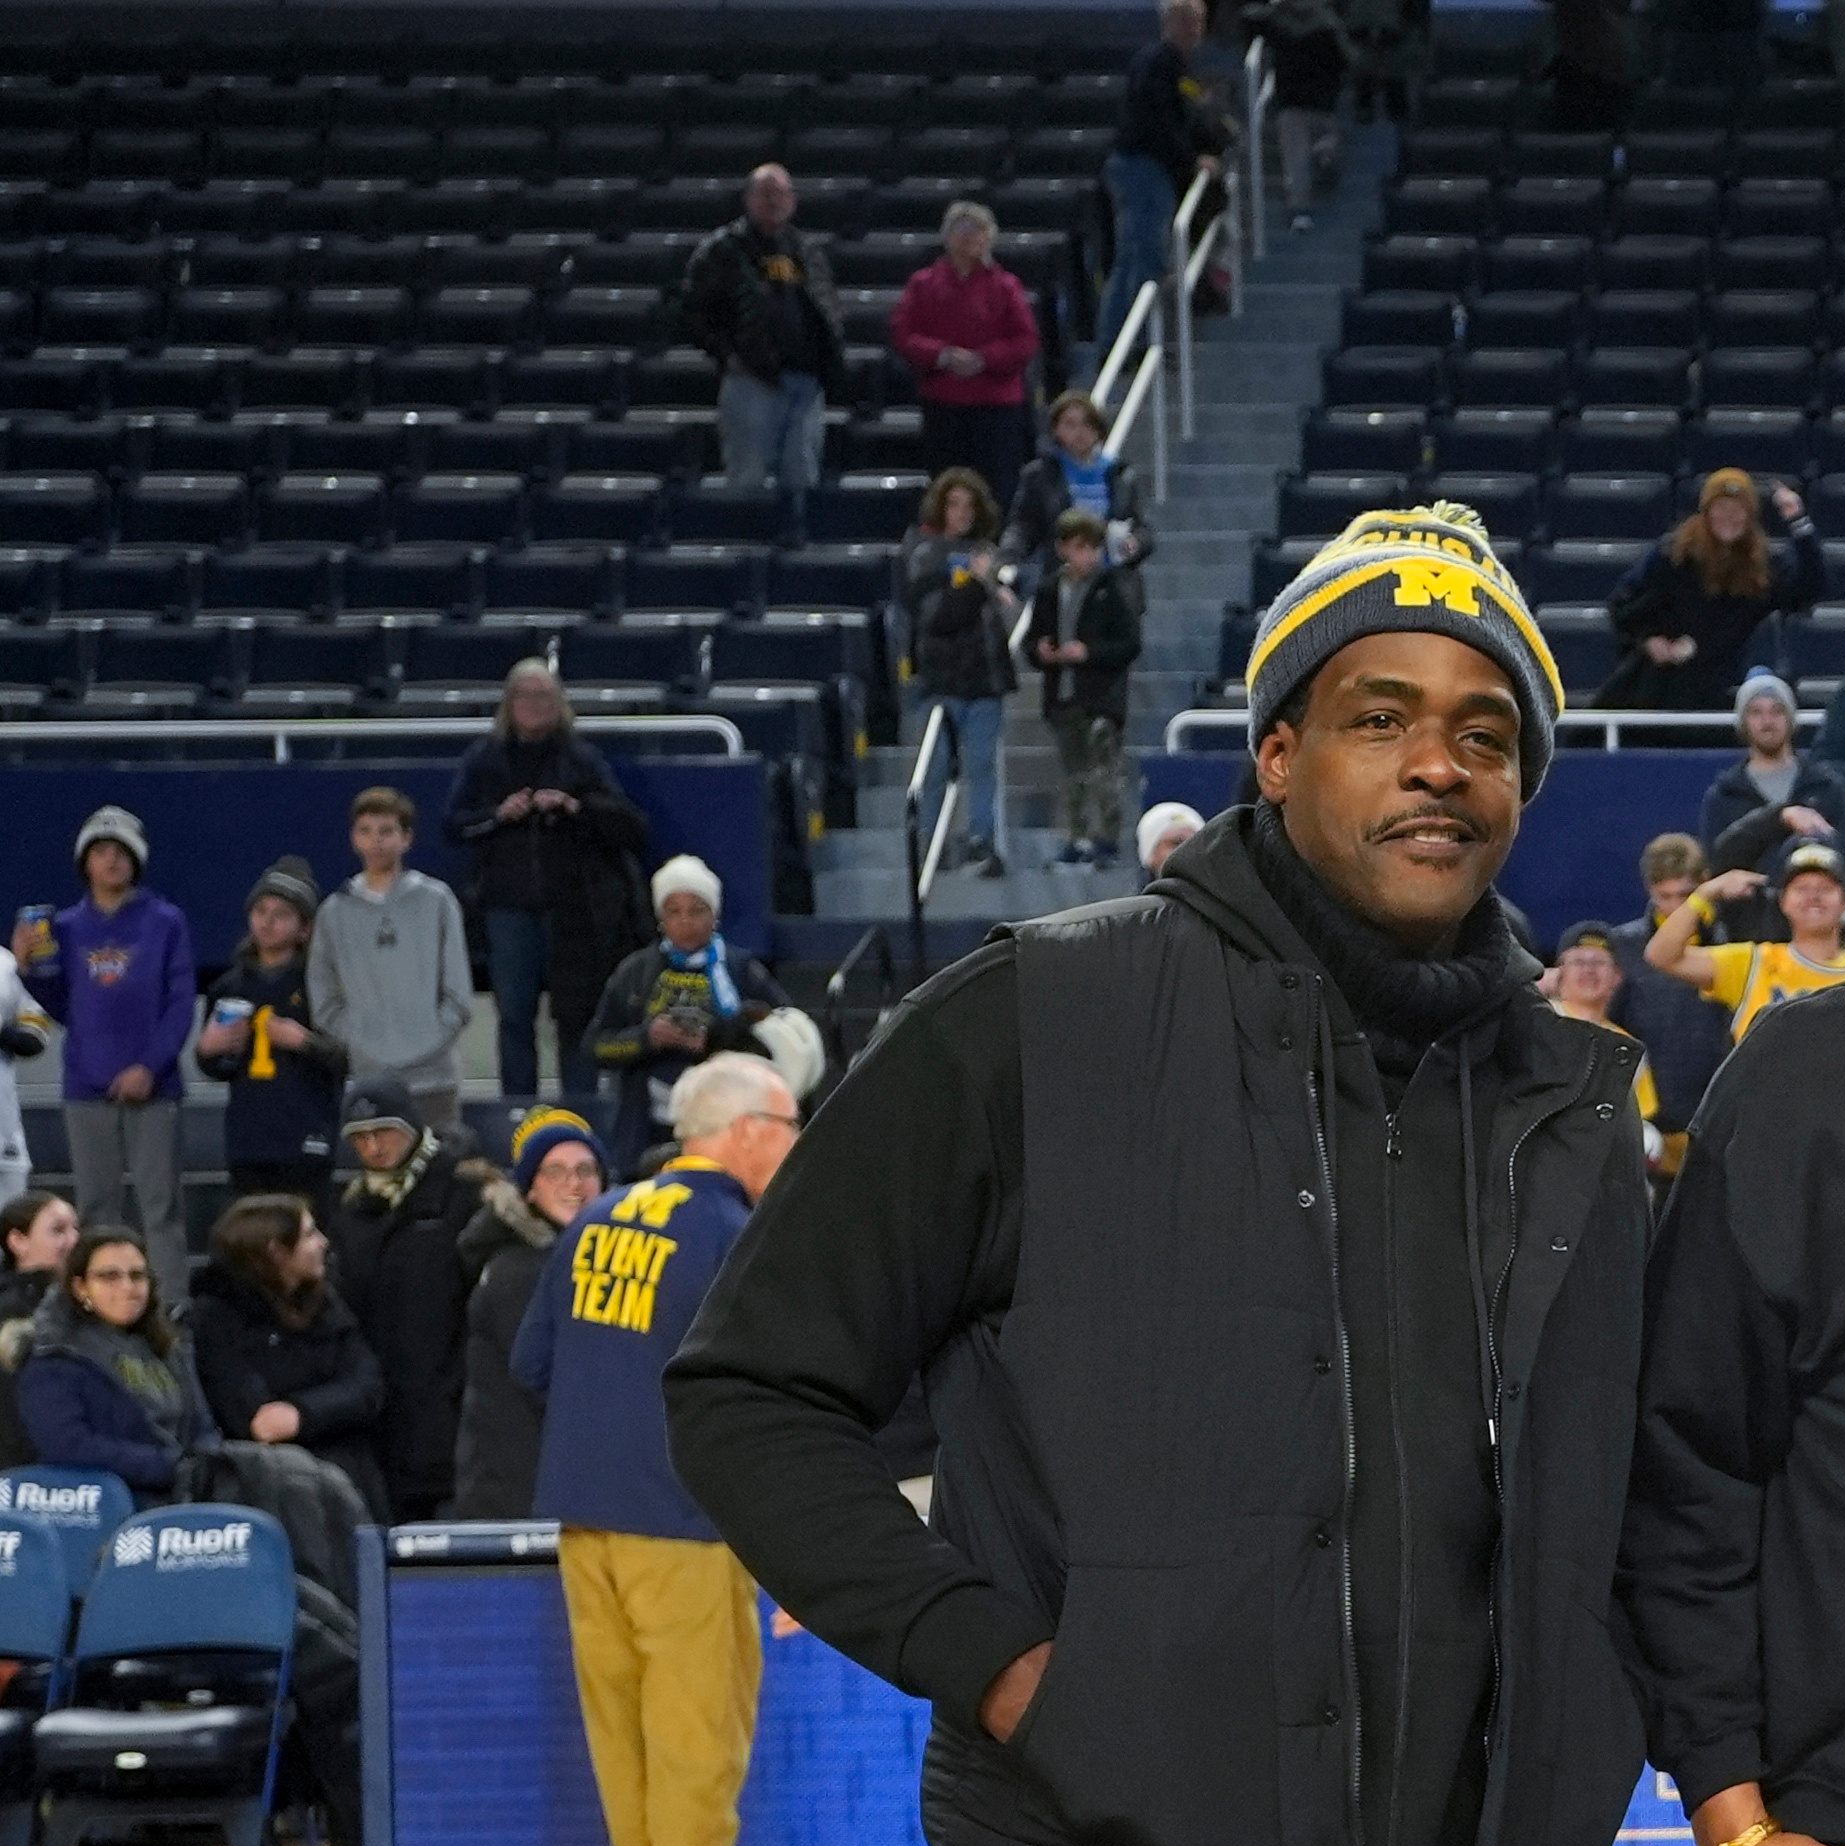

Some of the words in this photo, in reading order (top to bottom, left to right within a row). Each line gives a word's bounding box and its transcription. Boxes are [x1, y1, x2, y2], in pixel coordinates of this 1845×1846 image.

[1392, 562, 1481, 617] M
[610, 1179, 694, 1229] M
[572, 1223, 679, 1285] EVENT
[571, 1269, 659, 1334] TEAM
[16, 1482, 102, 1514] Ruoff
[158, 1522, 251, 1555] Ruoff
